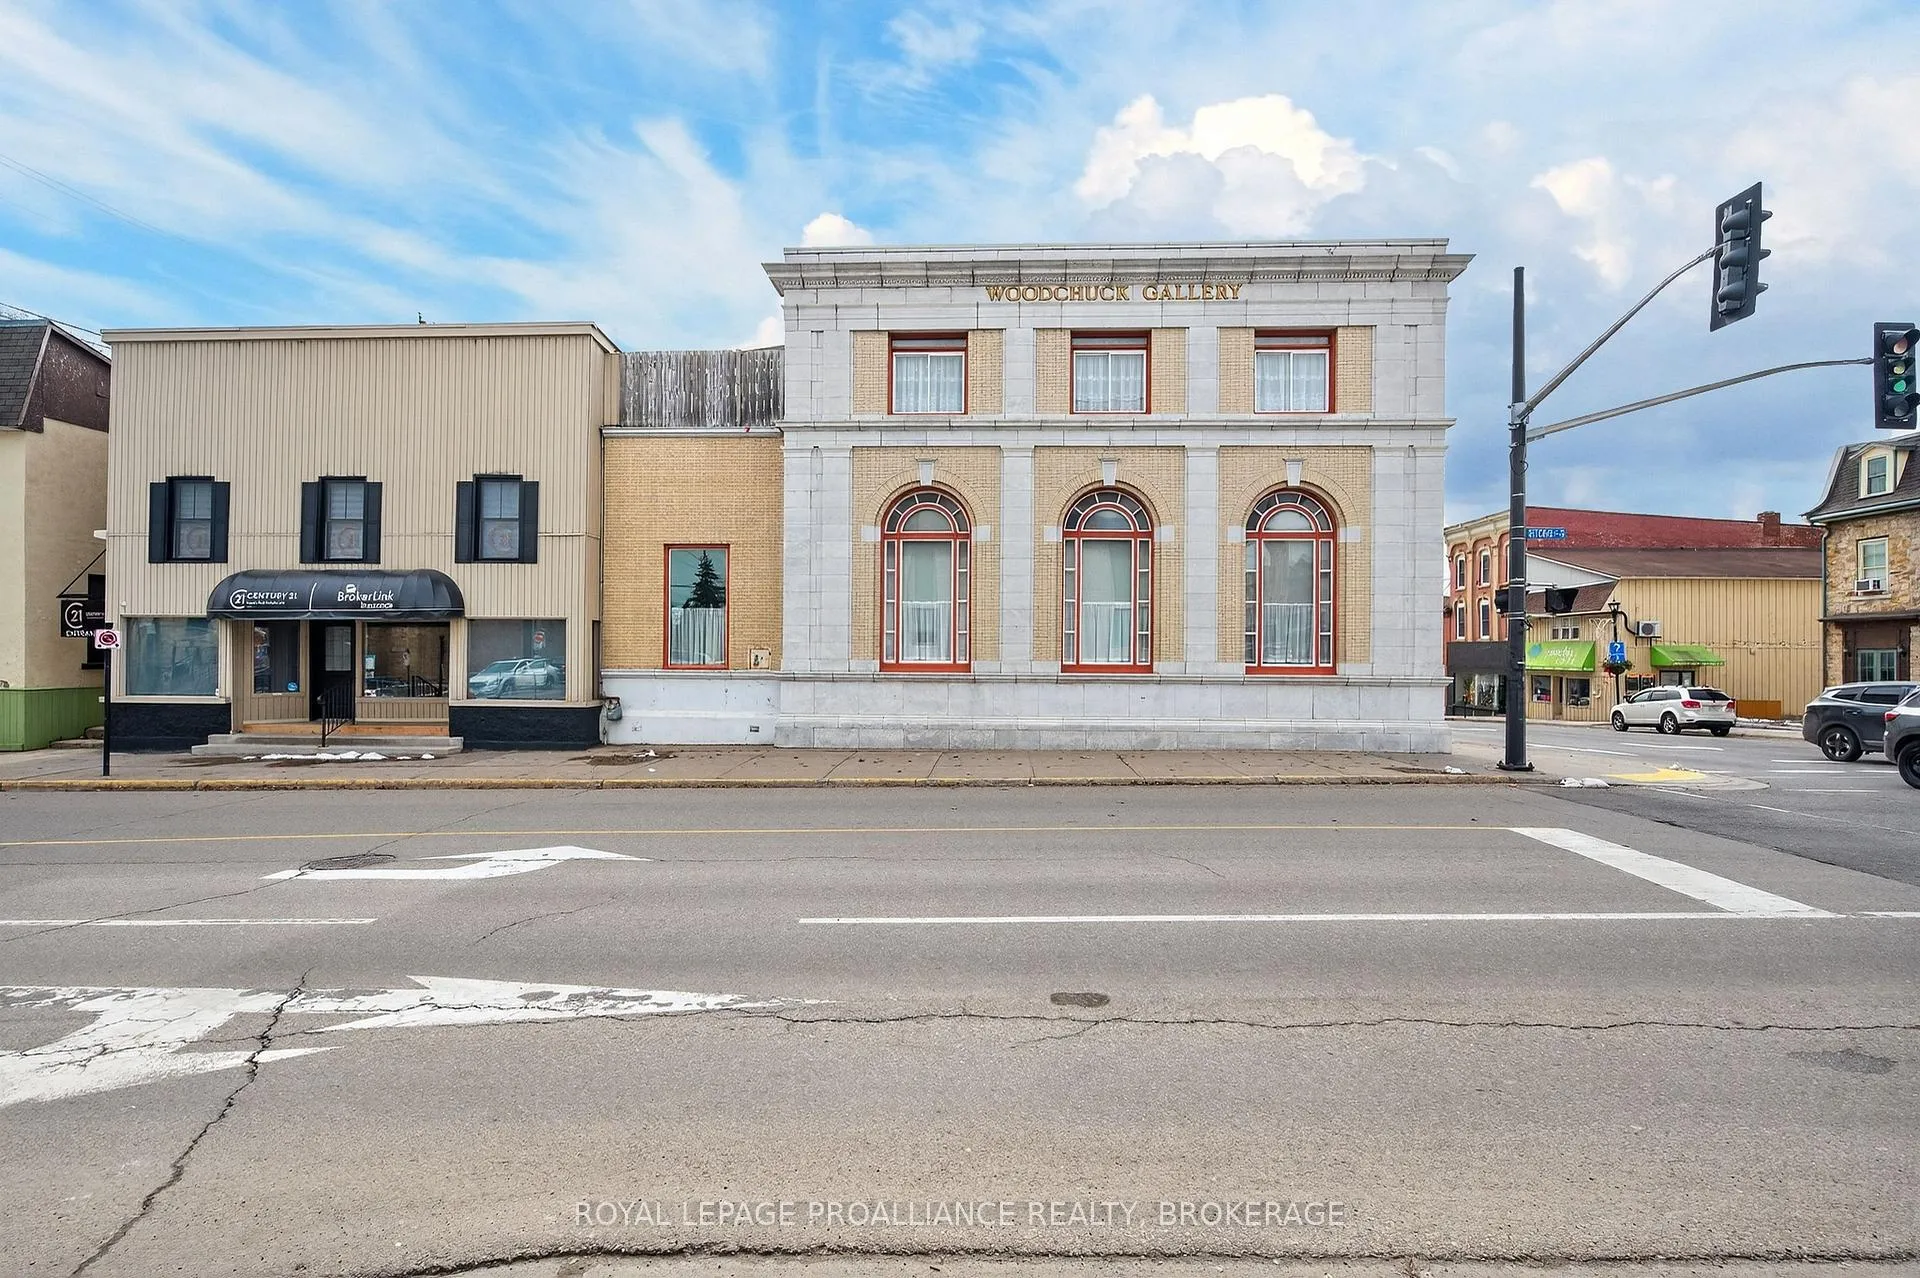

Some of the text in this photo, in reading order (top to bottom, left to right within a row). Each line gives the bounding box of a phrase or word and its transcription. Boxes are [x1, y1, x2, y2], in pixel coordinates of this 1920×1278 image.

[986, 284, 1242, 302] WOODCHUCK GALLERY
[247, 592, 288, 600] CENTURY
[337, 590, 394, 602] BrokerLink
